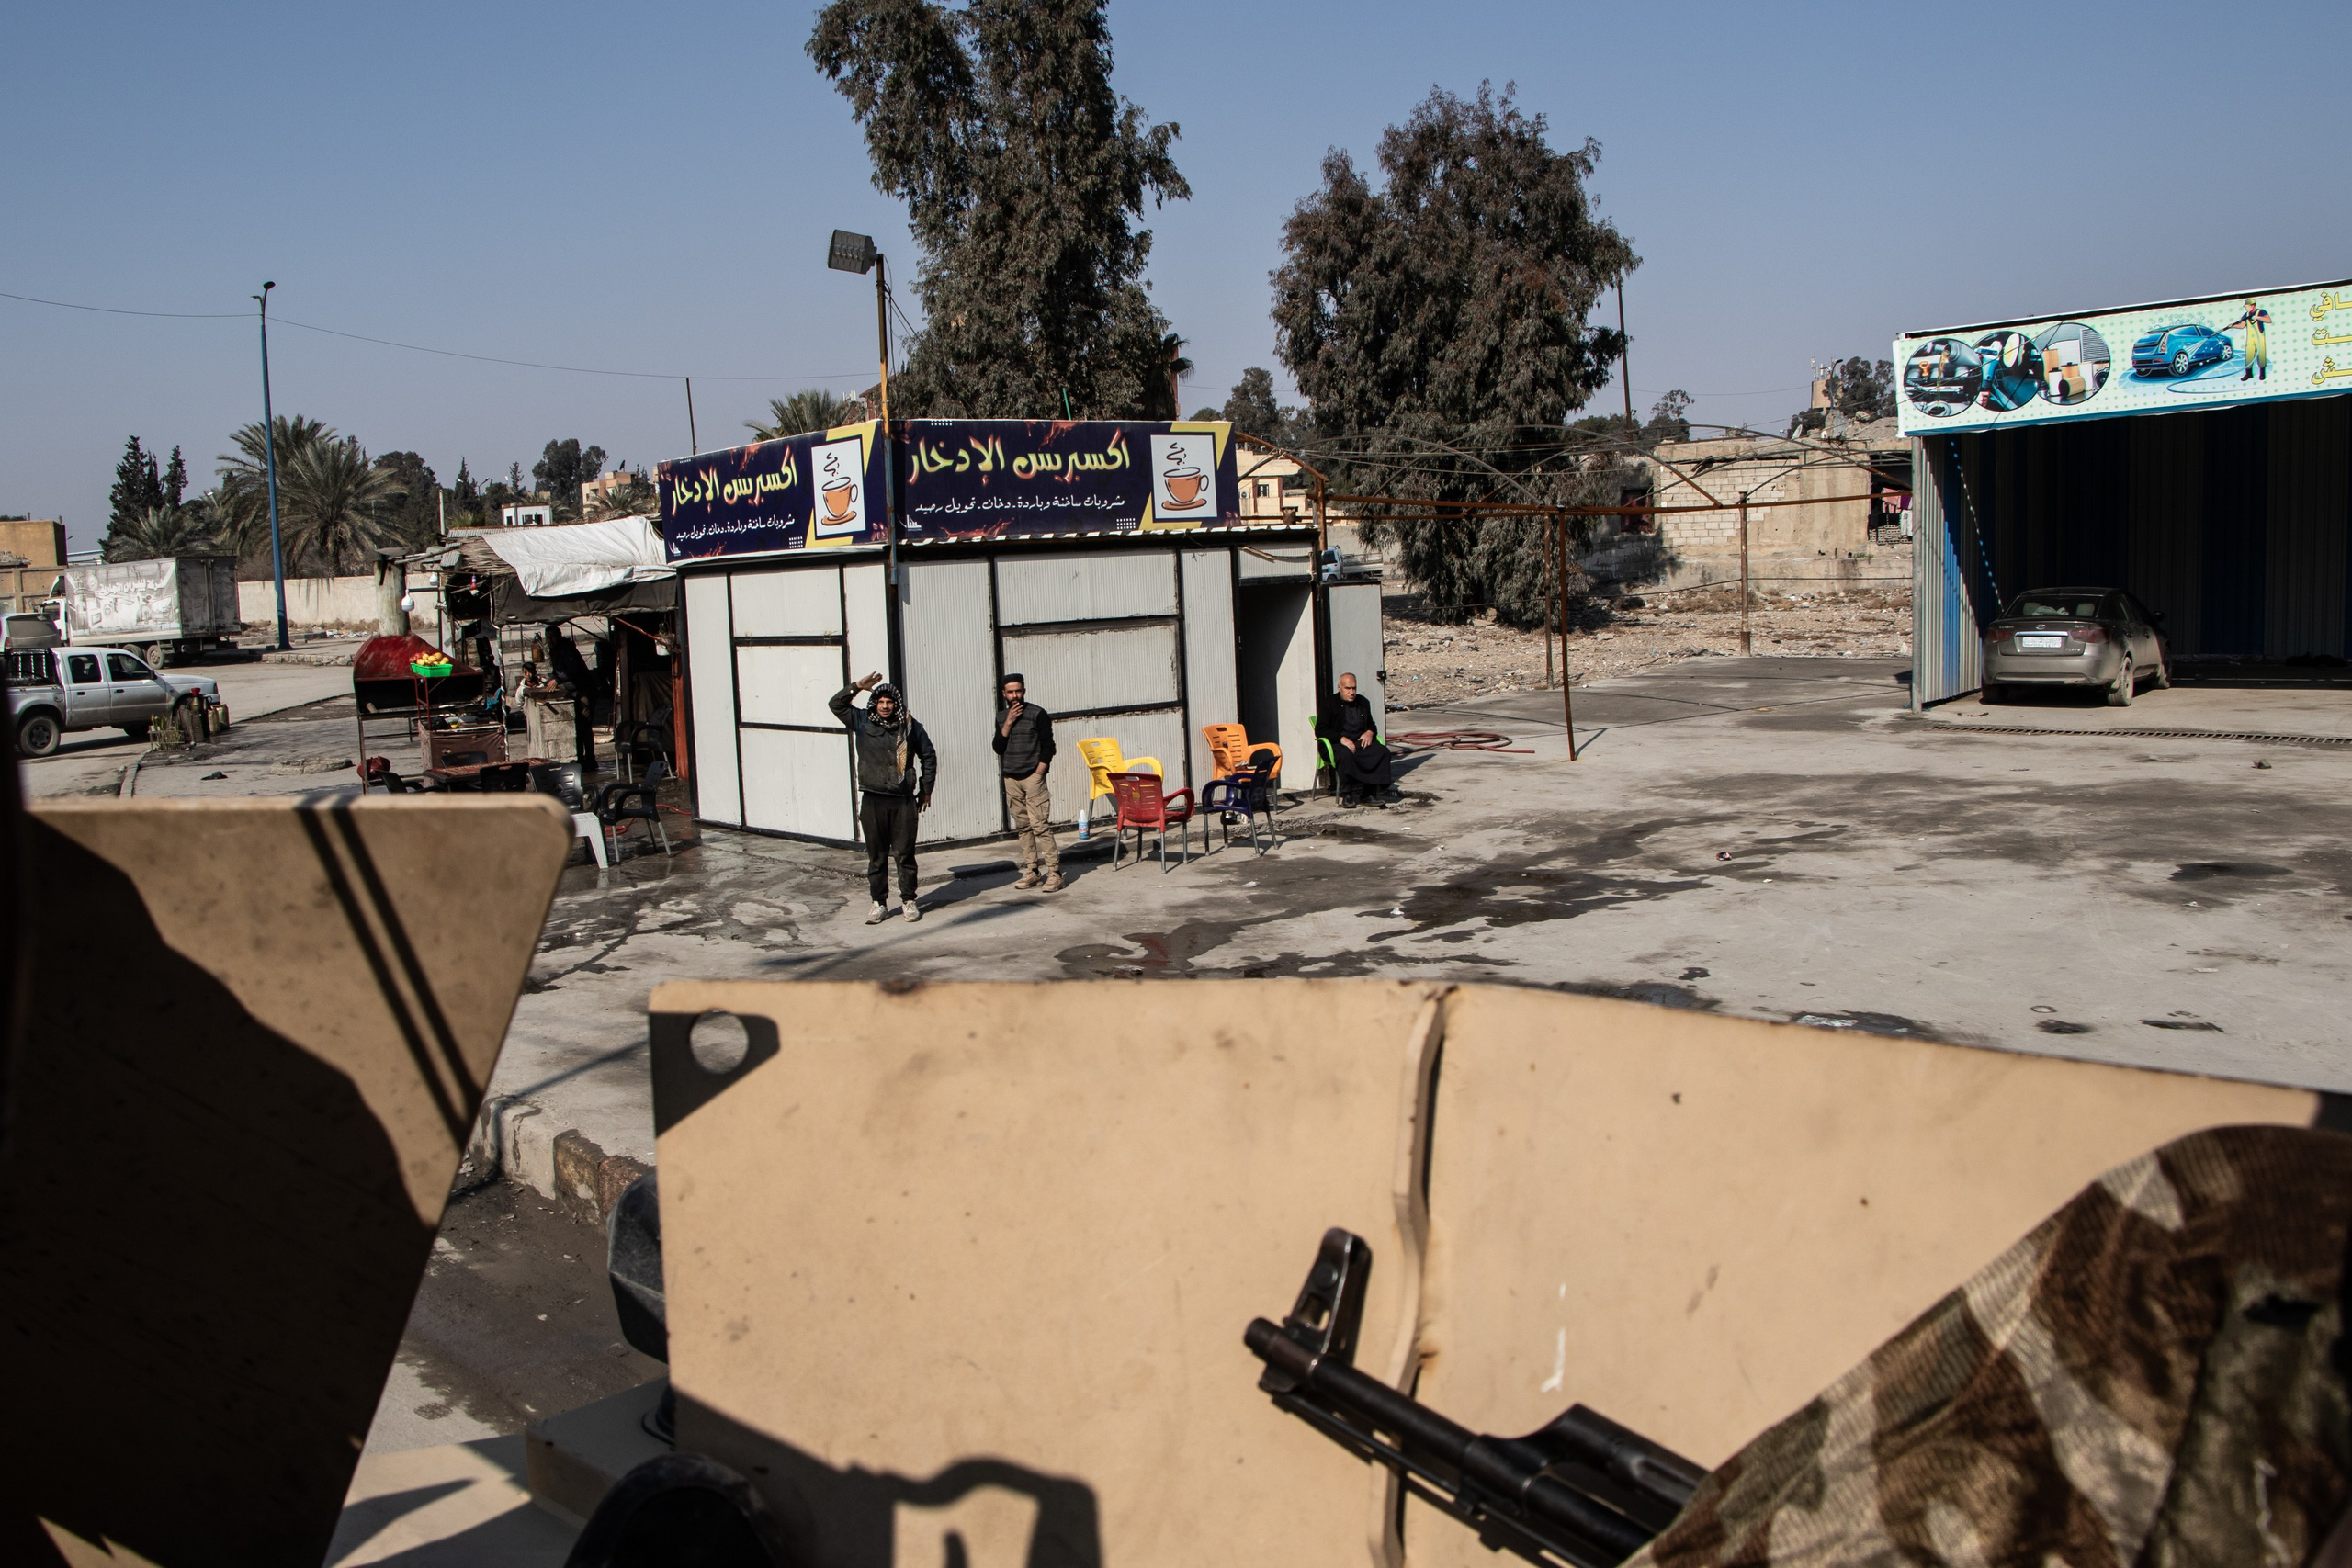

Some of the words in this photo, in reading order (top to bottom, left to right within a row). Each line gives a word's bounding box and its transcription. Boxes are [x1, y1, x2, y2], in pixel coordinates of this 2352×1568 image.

[1012, 427, 1131, 485] اكسبريس
[723, 445, 797, 506] اكسبريس
[914, 503, 944, 515] رصيد
[944, 496, 977, 513] تحويل
[1052, 494, 1082, 508] ساخنة
[1083, 493, 1125, 510] مشروبات
[747, 516, 766, 530] ساخنة
[766, 513, 796, 529] مشروبات
[676, 531, 690, 542] رصيد
[690, 524, 707, 540] تحويل
